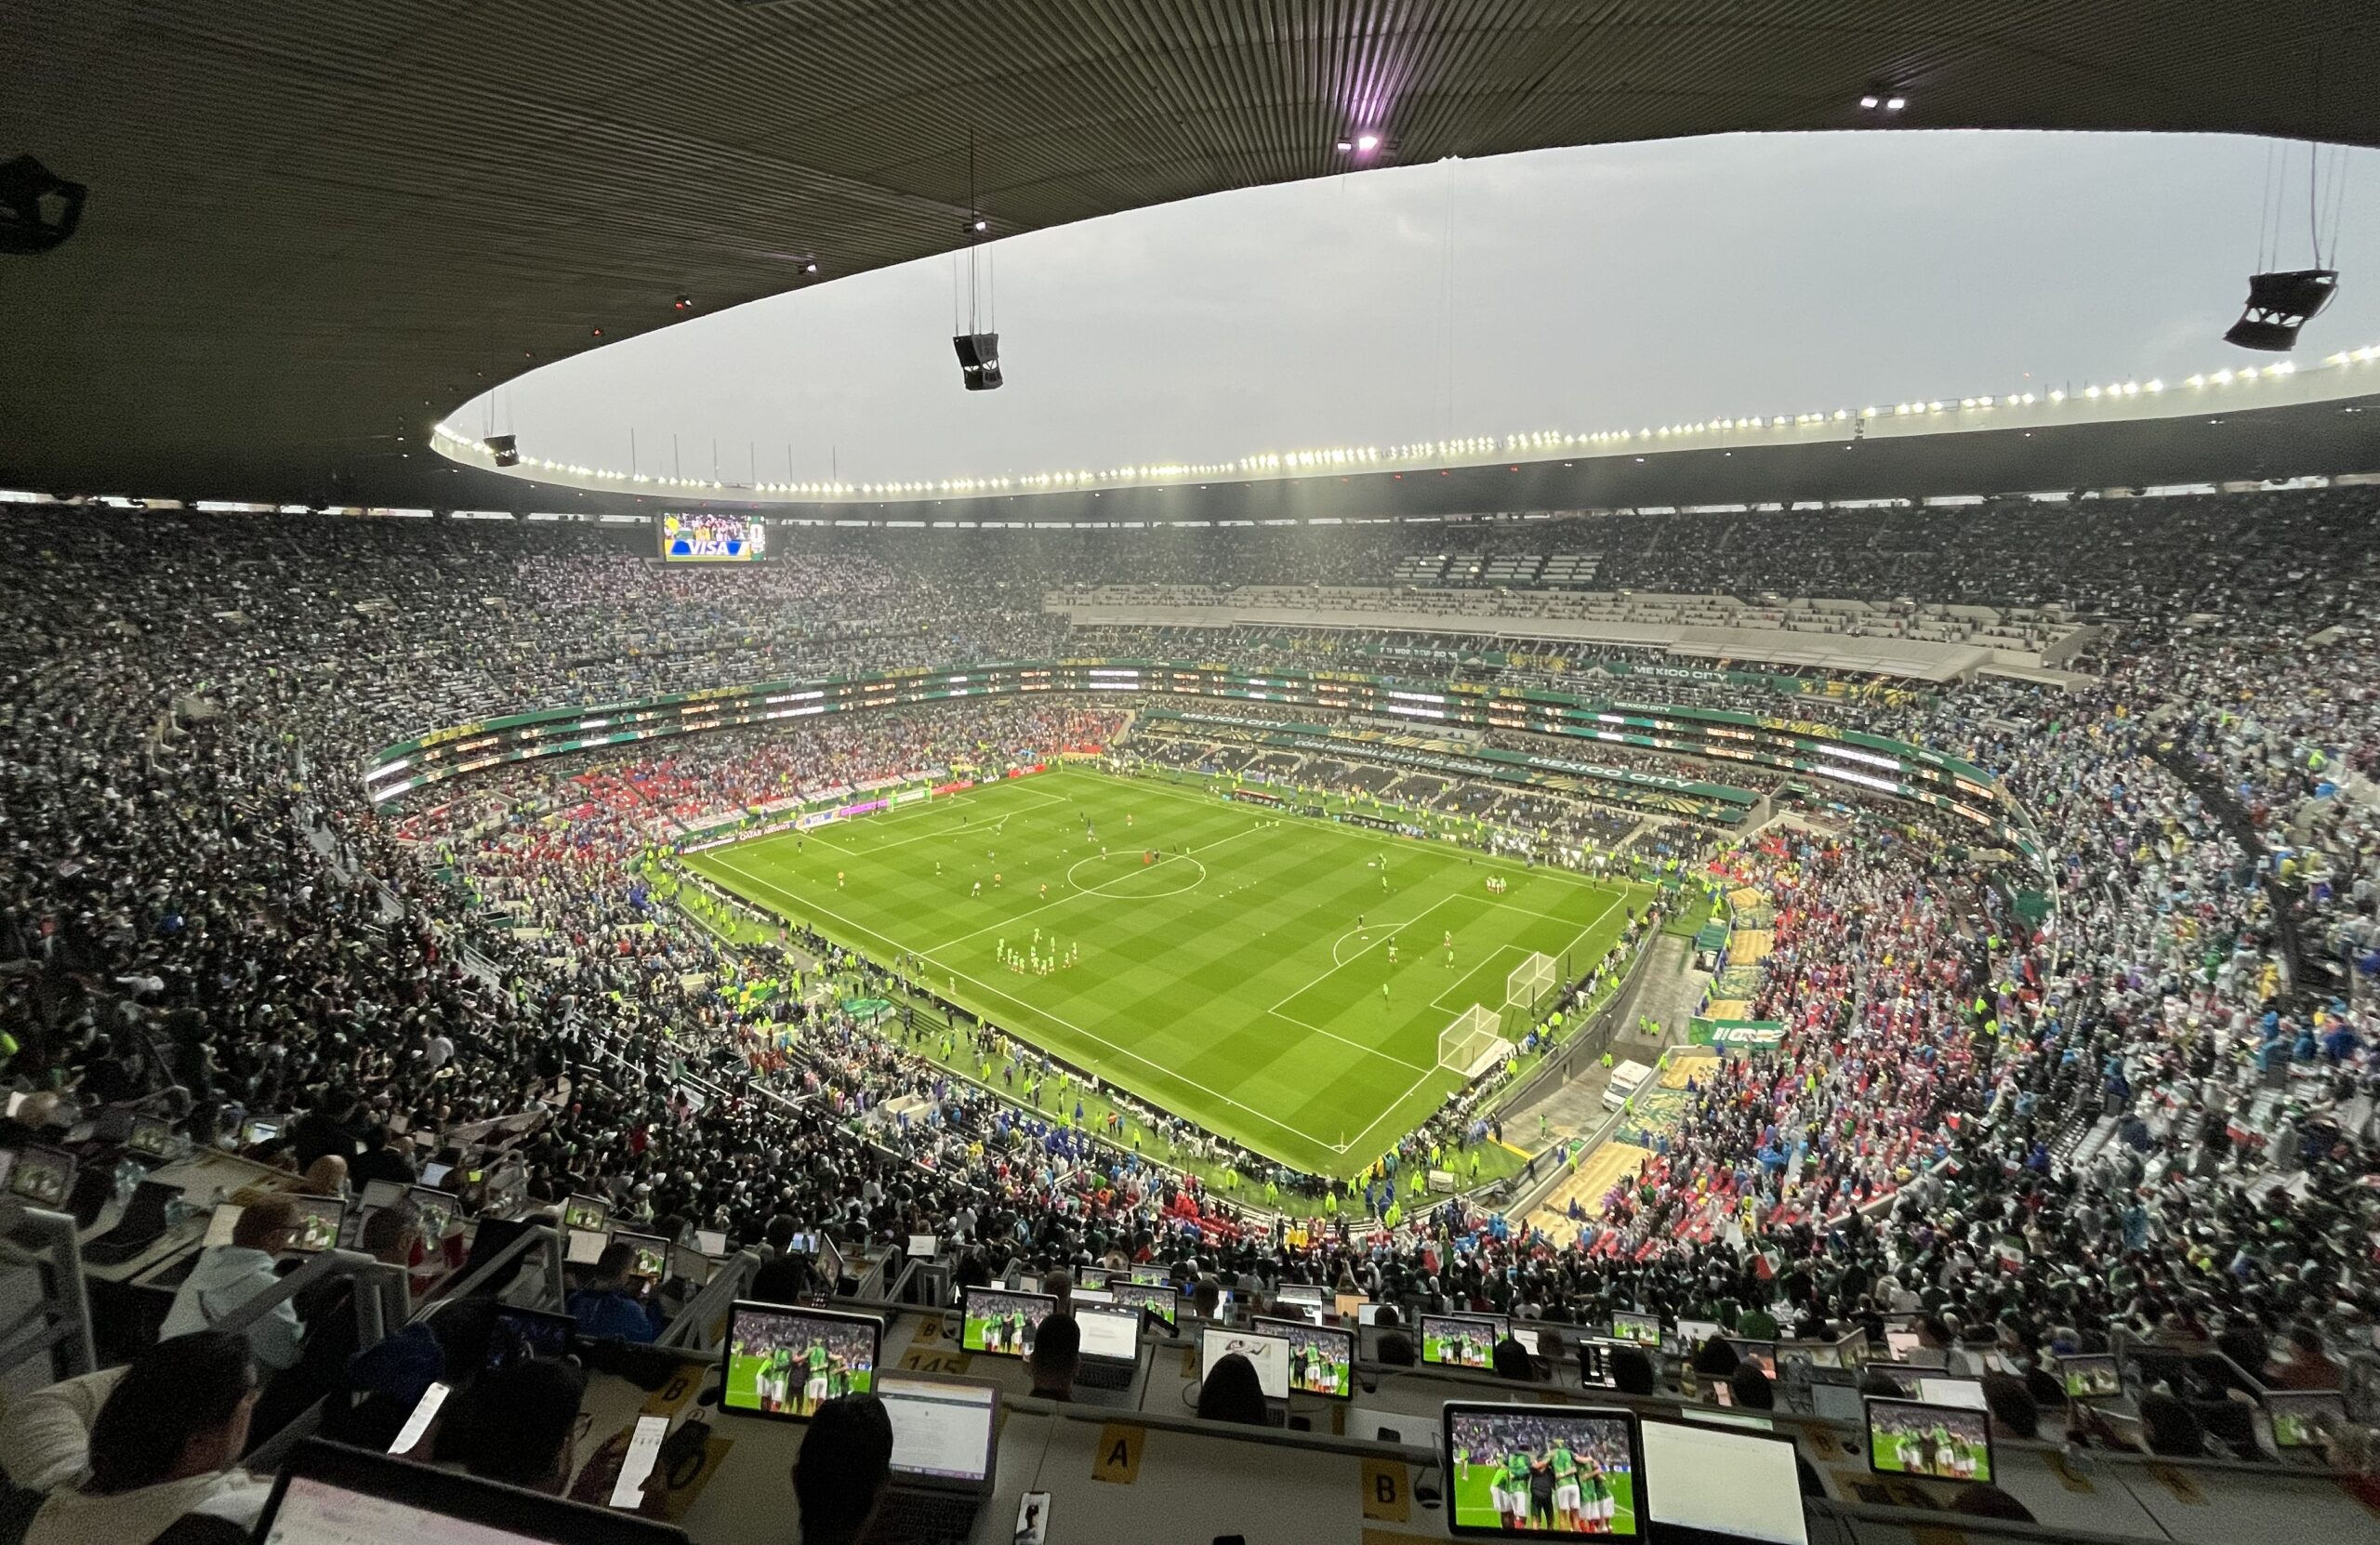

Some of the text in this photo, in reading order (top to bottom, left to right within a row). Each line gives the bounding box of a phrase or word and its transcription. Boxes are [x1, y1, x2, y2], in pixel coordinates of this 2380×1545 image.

[688, 539, 729, 555] VISA
[1633, 666, 1689, 678] MEXICO
[1614, 701, 1671, 713] MEXICO CITY
[1181, 712, 1289, 728] MEXICO CITY
[1326, 744, 1379, 757] MUNDIAL
[1527, 756, 1694, 788] MEXICO CITY
[739, 823, 791, 841] QATAR AIRWAYS
[922, 1323, 936, 1337] B
[662, 1379, 688, 1401] B
[1107, 1439, 1128, 1467] A
[1376, 1473, 1396, 1503] B
